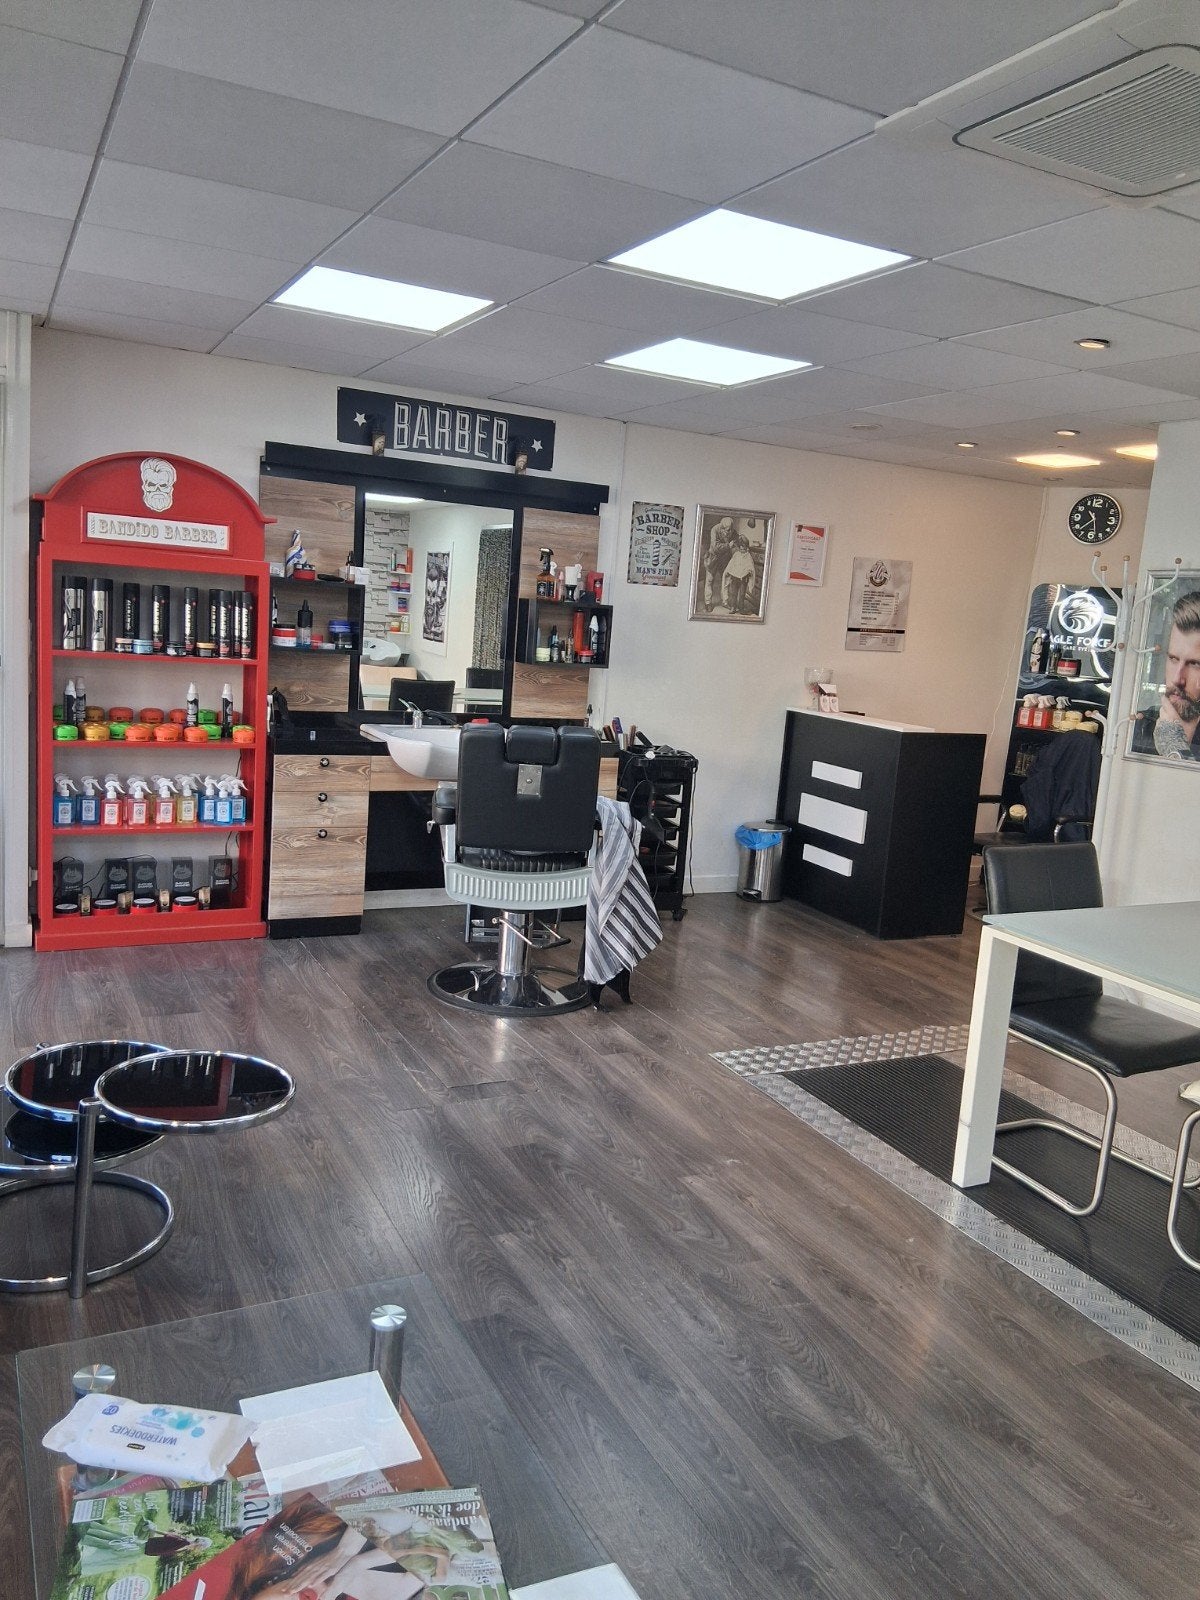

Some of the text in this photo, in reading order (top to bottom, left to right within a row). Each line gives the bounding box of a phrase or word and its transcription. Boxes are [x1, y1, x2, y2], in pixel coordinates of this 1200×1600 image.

[393, 401, 509, 464] BARBER
[1092, 498, 1103, 508] 12
[636, 513, 681, 530] BARBER
[1074, 513, 1081, 521] 9
[1106, 516, 1116, 525] 3
[98, 519, 218, 543] BANDIDO BARBER
[646, 525, 670, 536] SHOP
[1087, 531, 1095, 539] 6
[1042, 634, 1111, 648] AGLE FOCE
[110, 1424, 178, 1446] WATERDOEKJES
[438, 1503, 452, 1518] ik
[456, 1501, 480, 1515] doe
[273, 1545, 295, 1565] Samen
